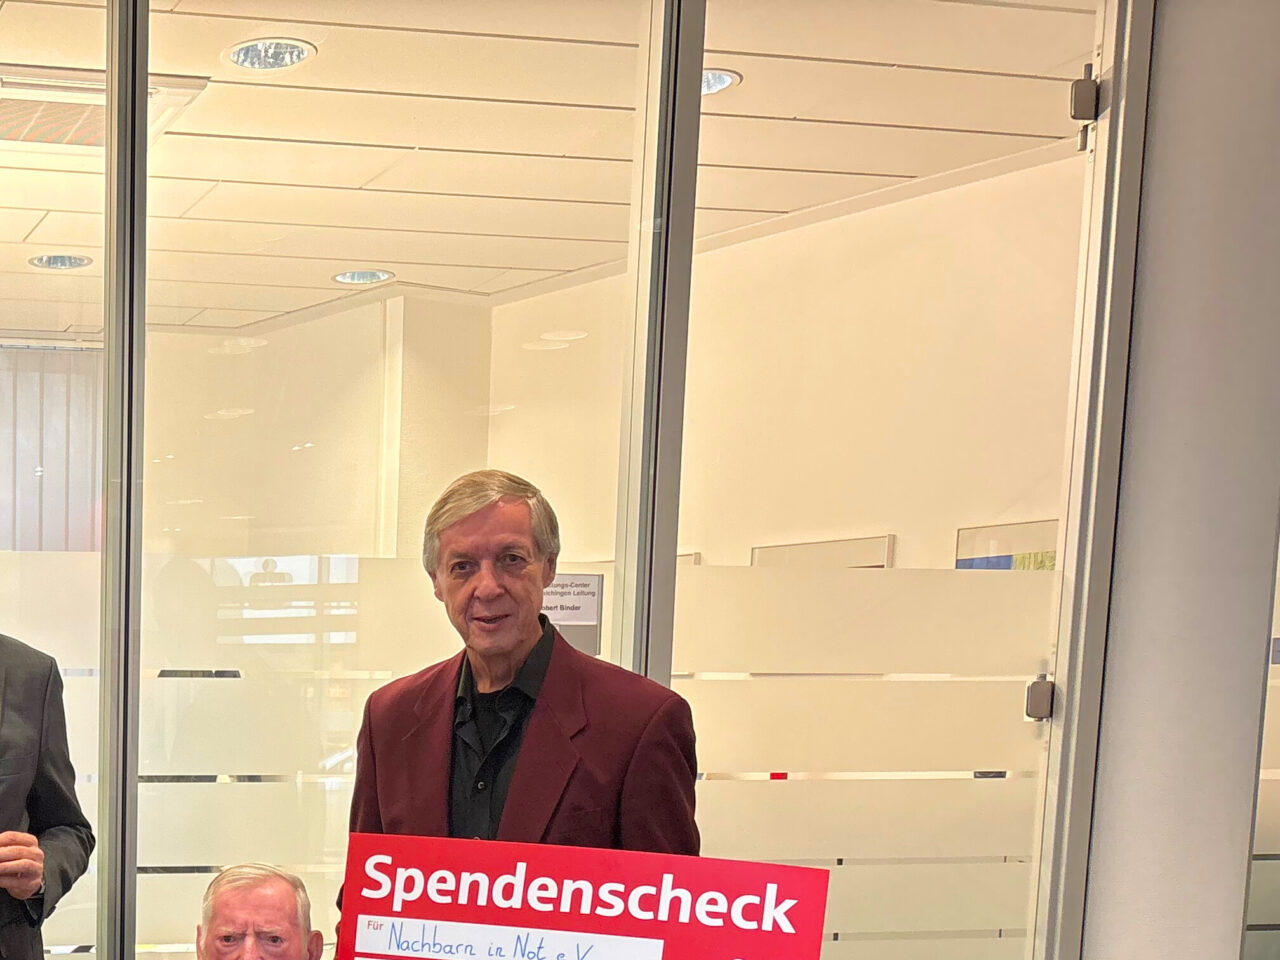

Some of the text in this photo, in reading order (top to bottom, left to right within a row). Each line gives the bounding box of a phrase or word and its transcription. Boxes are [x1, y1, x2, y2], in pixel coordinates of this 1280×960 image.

[360, 853, 799, 934] Spendenscheck
[367, 920, 384, 931] Für
[388, 921, 476, 956] Nachbarn
[488, 942, 506, 958] in
[513, 932, 546, 960] Not
